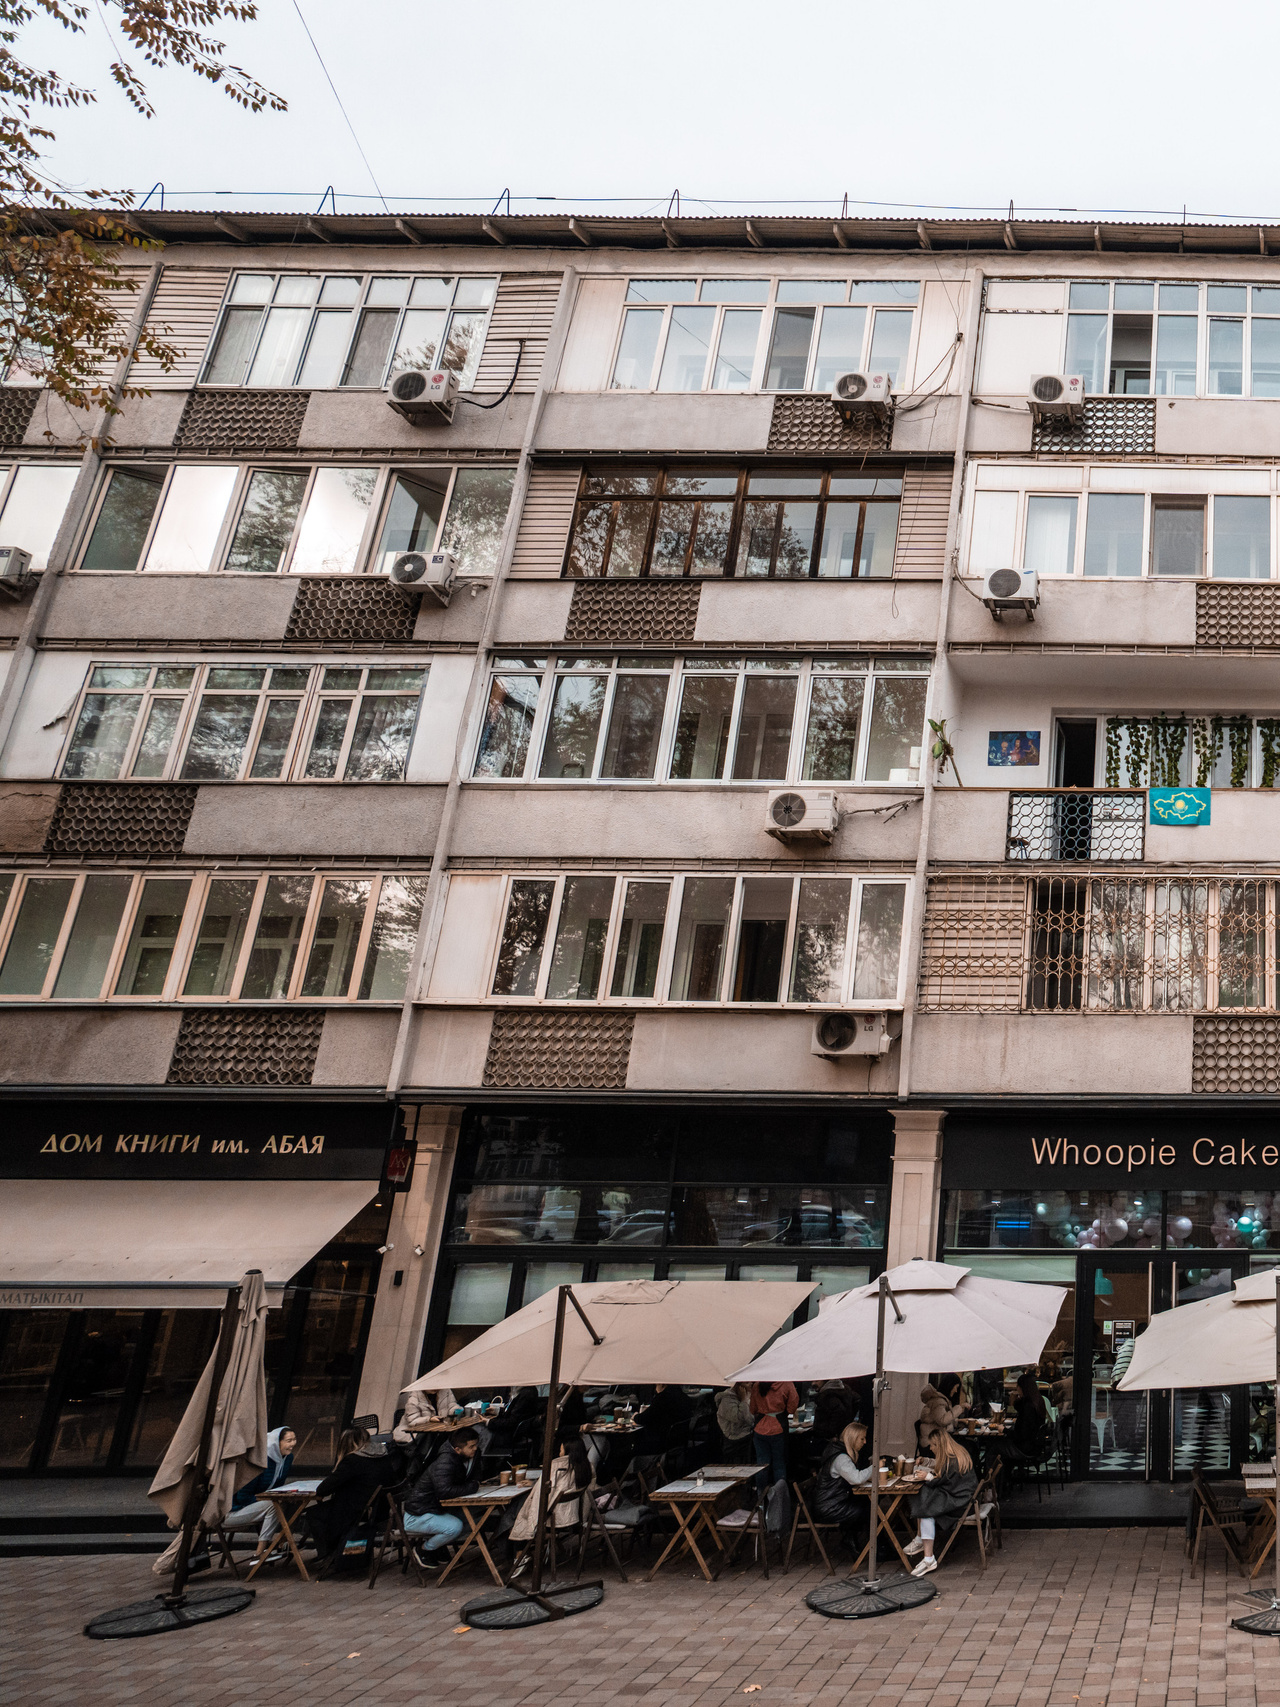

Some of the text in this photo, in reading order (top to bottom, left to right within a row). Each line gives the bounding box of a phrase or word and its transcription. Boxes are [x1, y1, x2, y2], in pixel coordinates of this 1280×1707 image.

[40, 1133, 325, 1154] ДОМ КНИГИ им. АБАЯ
[1031, 1137, 1177, 1173] Whoopie
